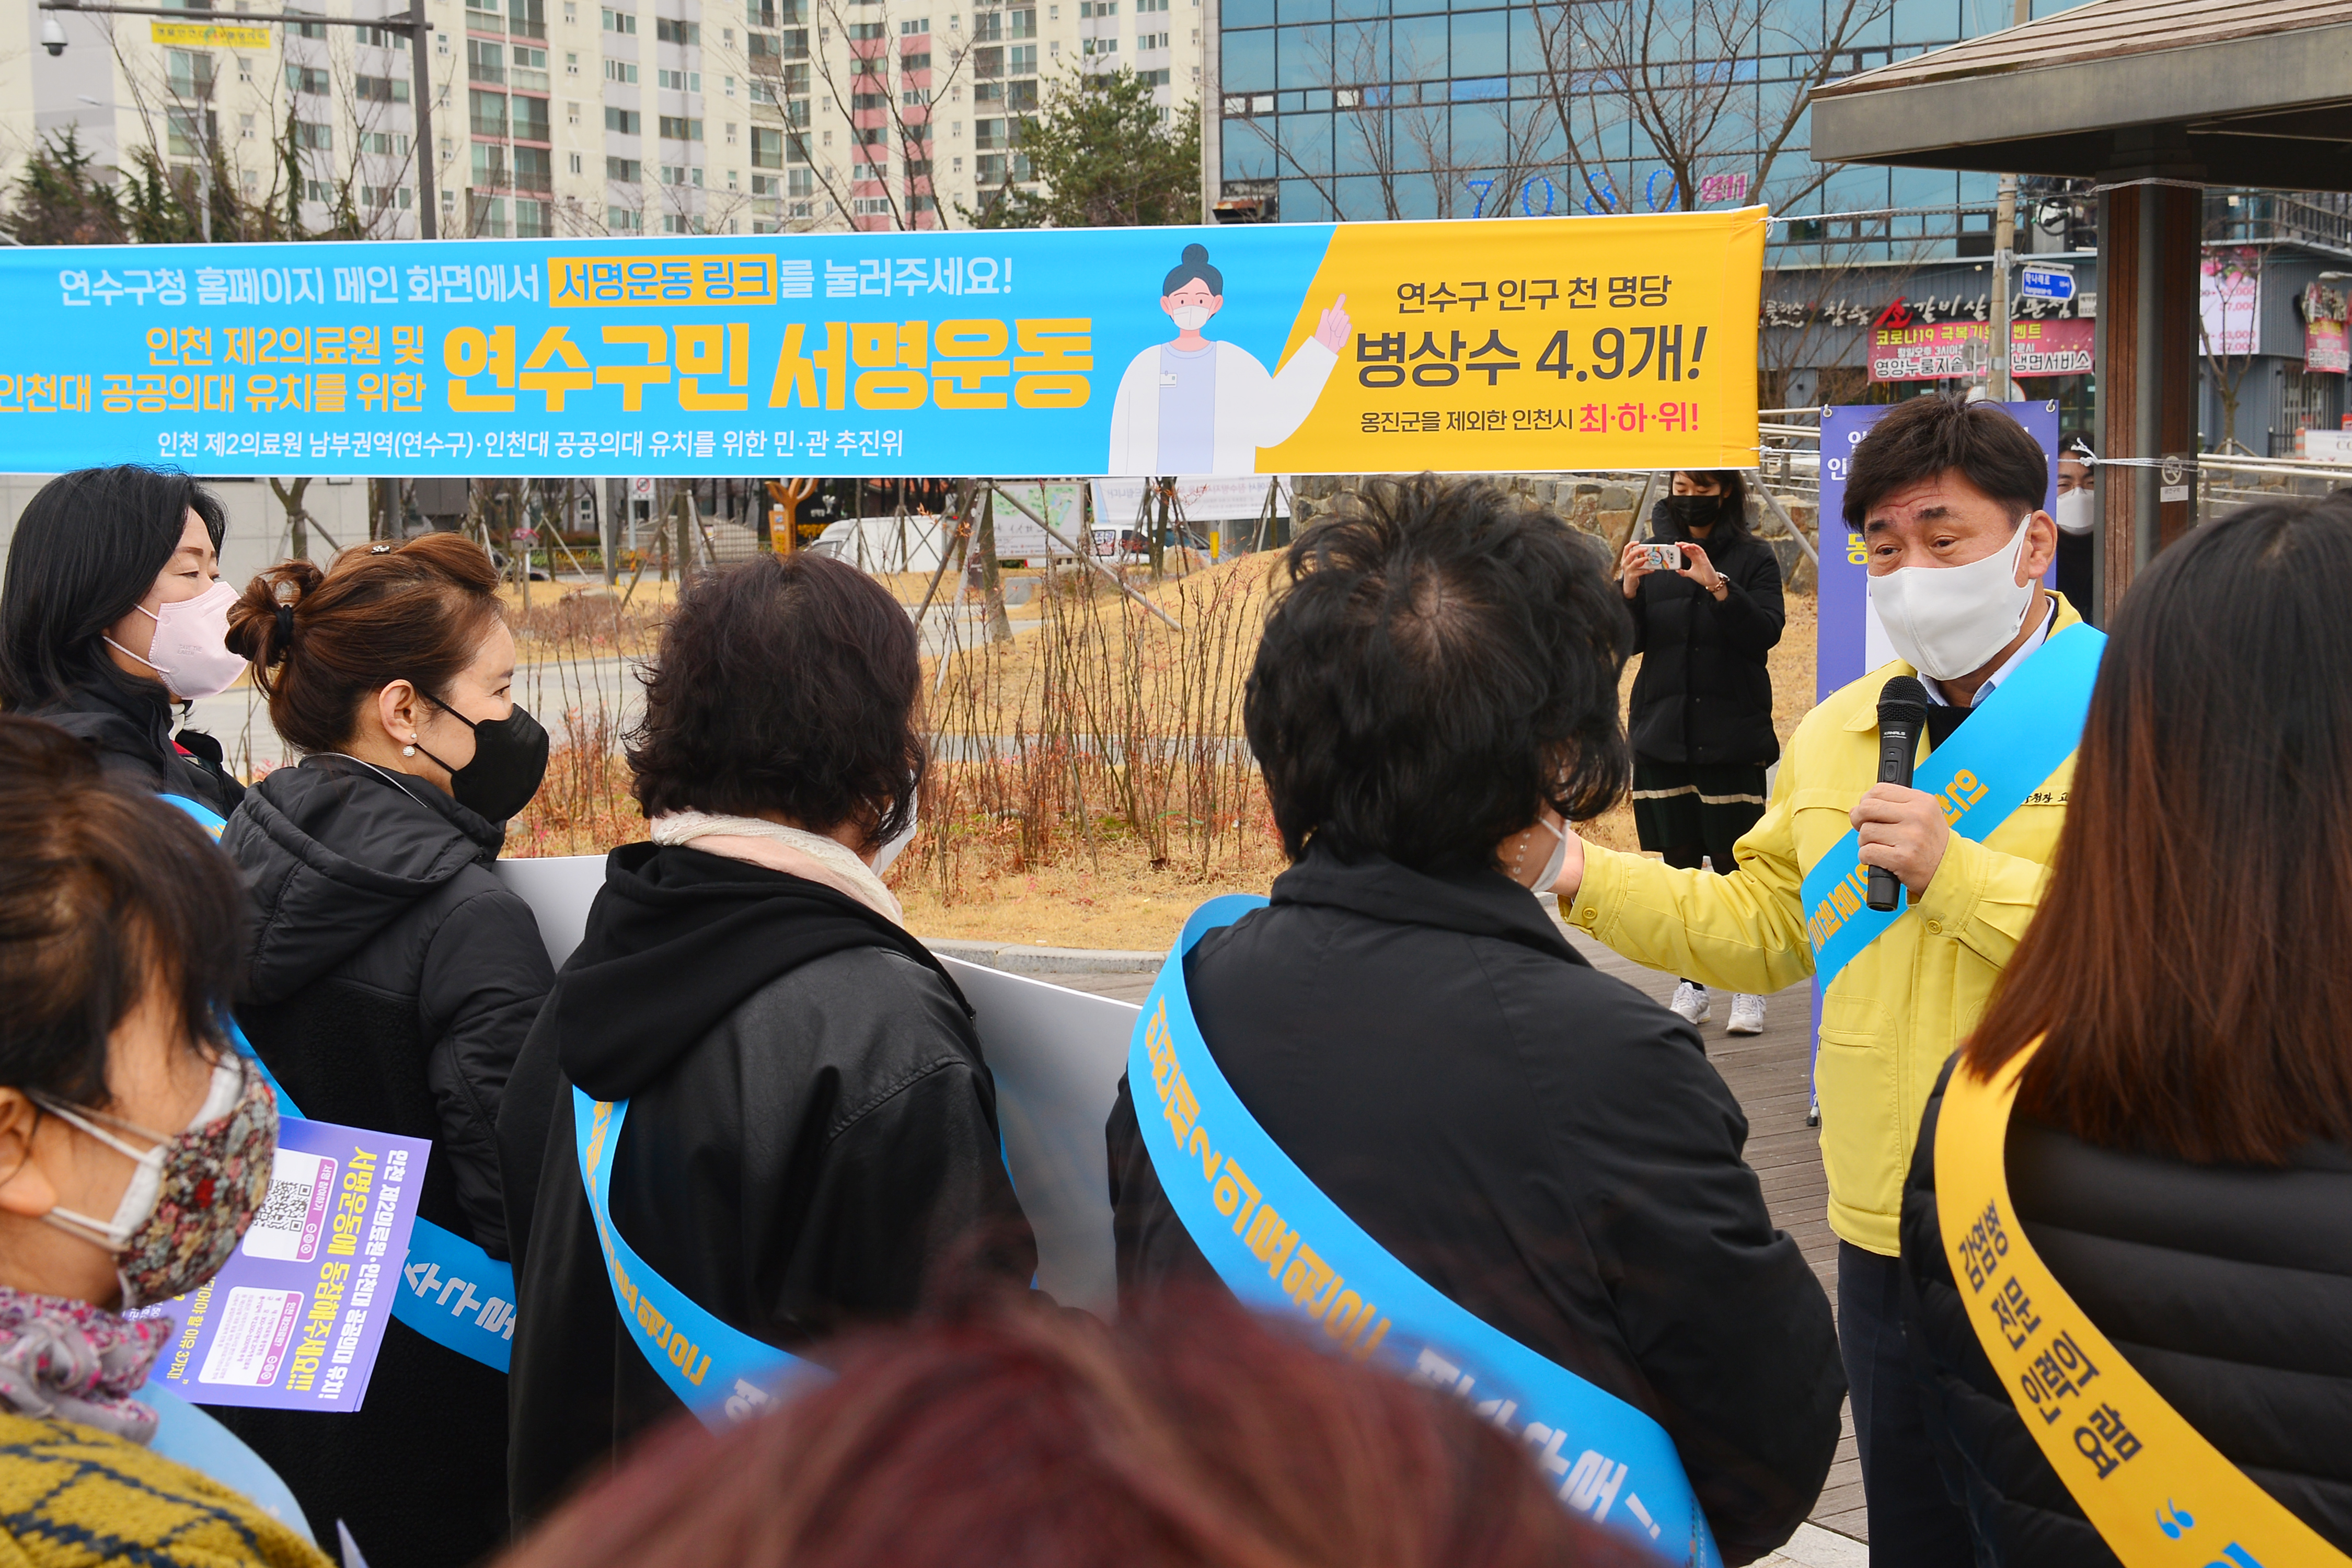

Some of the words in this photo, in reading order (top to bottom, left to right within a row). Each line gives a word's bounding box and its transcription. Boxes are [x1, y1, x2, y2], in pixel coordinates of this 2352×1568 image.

[60, 270, 186, 306] 연수구청
[195, 267, 324, 305] 홈페이지
[335, 266, 398, 304] 메인
[407, 263, 538, 303] 화면에서
[559, 262, 693, 301] 서명운동
[824, 257, 1012, 297] 눌러주세요!
[1397, 282, 1489, 314] 연수구
[1497, 280, 1559, 312] 인구
[1568, 278, 1598, 309] 천
[1608, 275, 1672, 307] 명당
[146, 327, 212, 365] 인천
[223, 326, 381, 365] 제2의료원
[392, 326, 424, 364] 및
[1876, 328, 1935, 345] 코로나19
[2013, 323, 2041, 339] 벤트
[444, 322, 749, 412] 연수구민
[768, 318, 1093, 410] 서명운동
[1356, 330, 1520, 388] 병상수
[1536, 324, 1707, 381] 4.9개!
[0, 374, 91, 412] 인천대
[101, 374, 234, 412] 공공의대
[245, 373, 347, 412] 유치를
[357, 373, 426, 411] 위한
[1361, 410, 1441, 433] 옹진군을
[1446, 409, 1507, 431] 제외한
[1512, 408, 1573, 431] 인천시
[1579, 402, 1699, 433] 최·하·위!
[158, 432, 198, 458] 인천
[204, 432, 302, 457] 제2의료원
[555, 431, 643, 458] 공공의대
[649, 431, 716, 458] 유치를
[722, 430, 767, 457] 위한
[774, 430, 829, 456] 민·관
[835, 430, 903, 456] 추진위
[320, 1165, 332, 1180] 서명
[384, 1150, 408, 1182] 인천
[313, 1181, 329, 1211] 참여하기
[327, 1146, 377, 1255] 서명운동에
[1958, 1198, 2009, 1295] 감염병
[403, 1249, 517, 1340] 수구로
[1991, 1276, 2042, 1352] 전문
[179, 1329, 199, 1348] 이유
[187, 1316, 204, 1327] 할
[286, 1261, 351, 1391] 동참해주세요!!!
[331, 1309, 367, 1364] 공공의대
[318, 1366, 349, 1399] 유치!
[2021, 1330, 2100, 1425] 인력의
[2072, 1403, 2143, 1480] 요람
